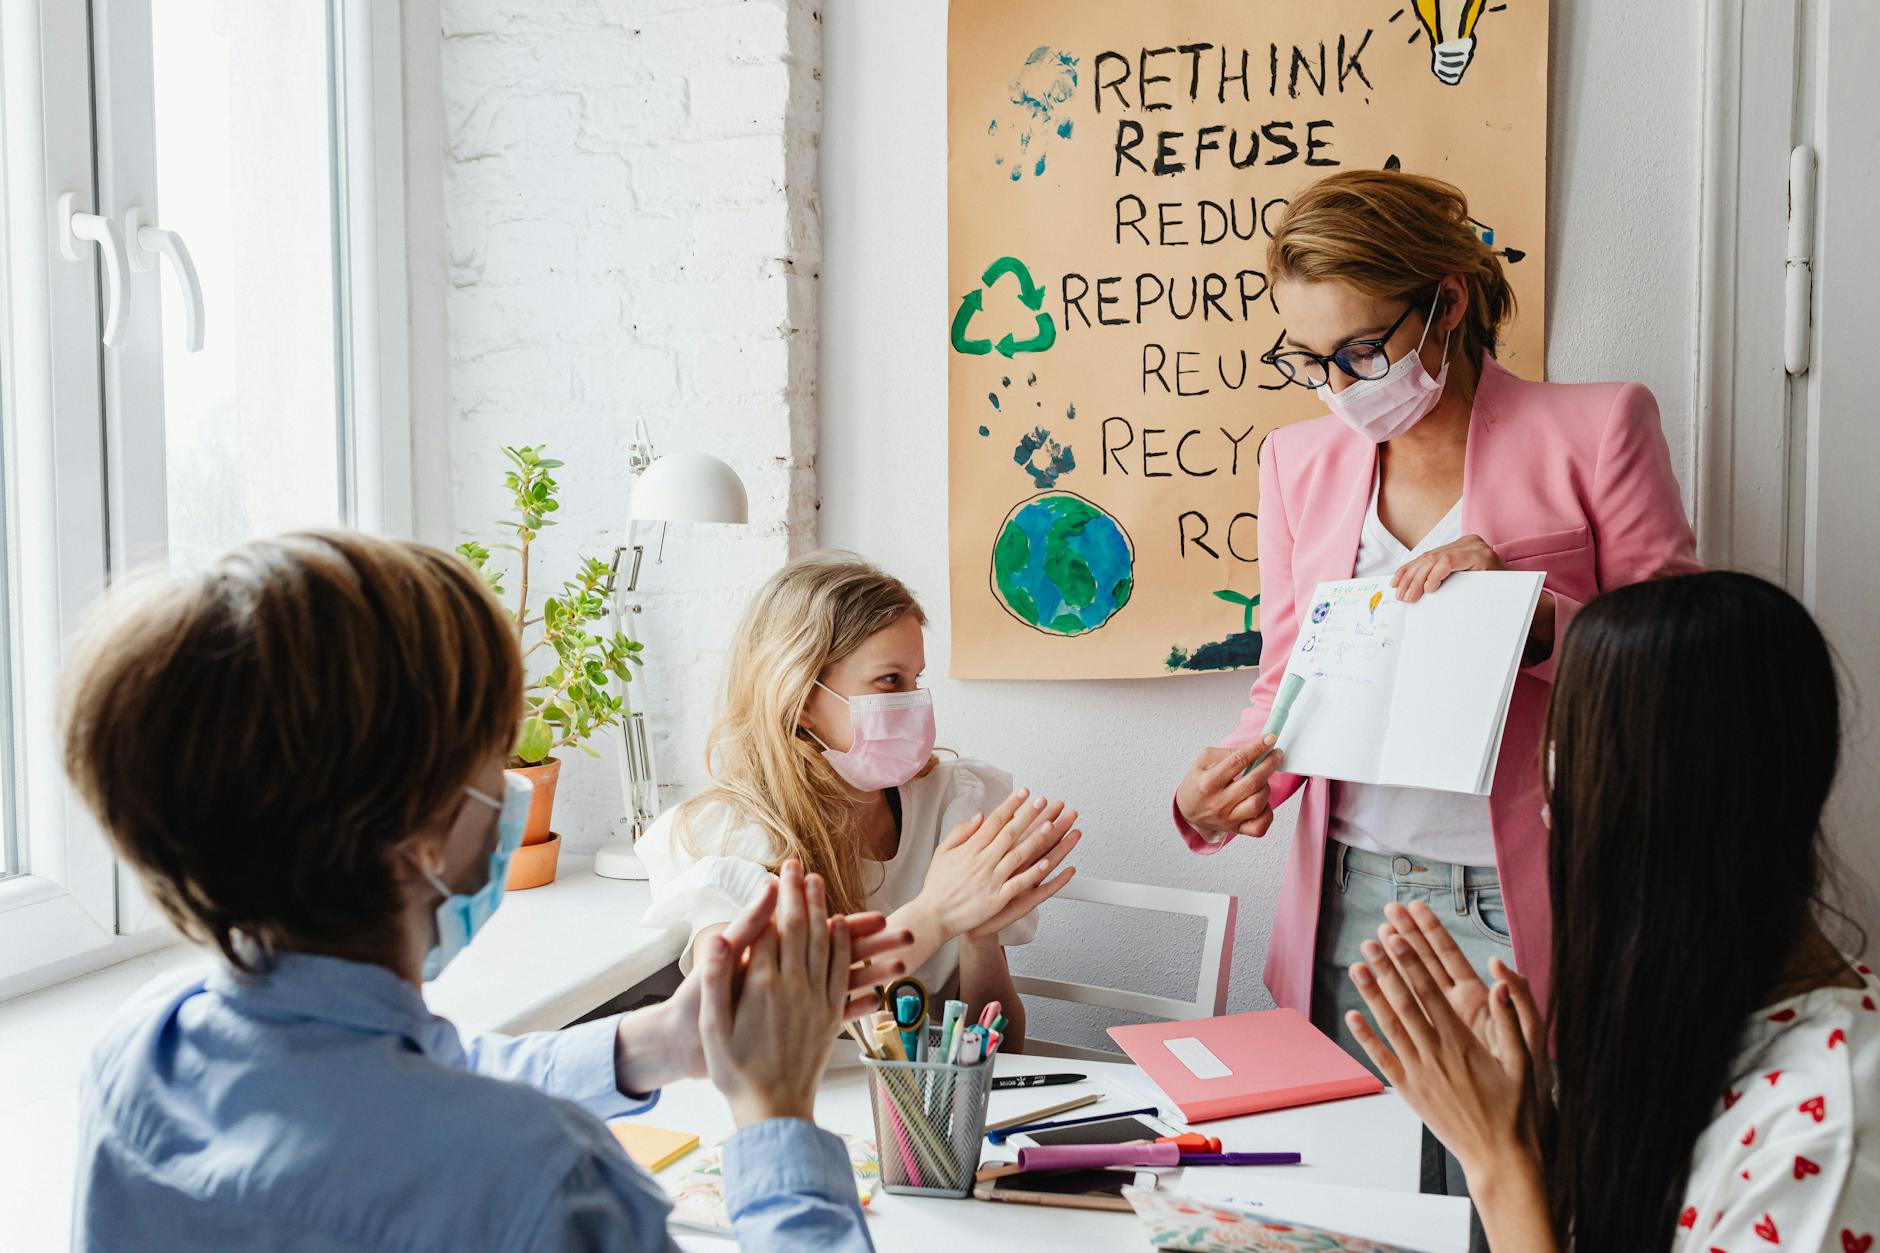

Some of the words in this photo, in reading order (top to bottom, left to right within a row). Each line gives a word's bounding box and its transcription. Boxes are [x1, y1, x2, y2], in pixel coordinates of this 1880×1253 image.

[1094, 29, 1374, 114] RETHINK
[1114, 119, 1341, 177] REFUSE
[1115, 193, 1289, 246] REDUC
